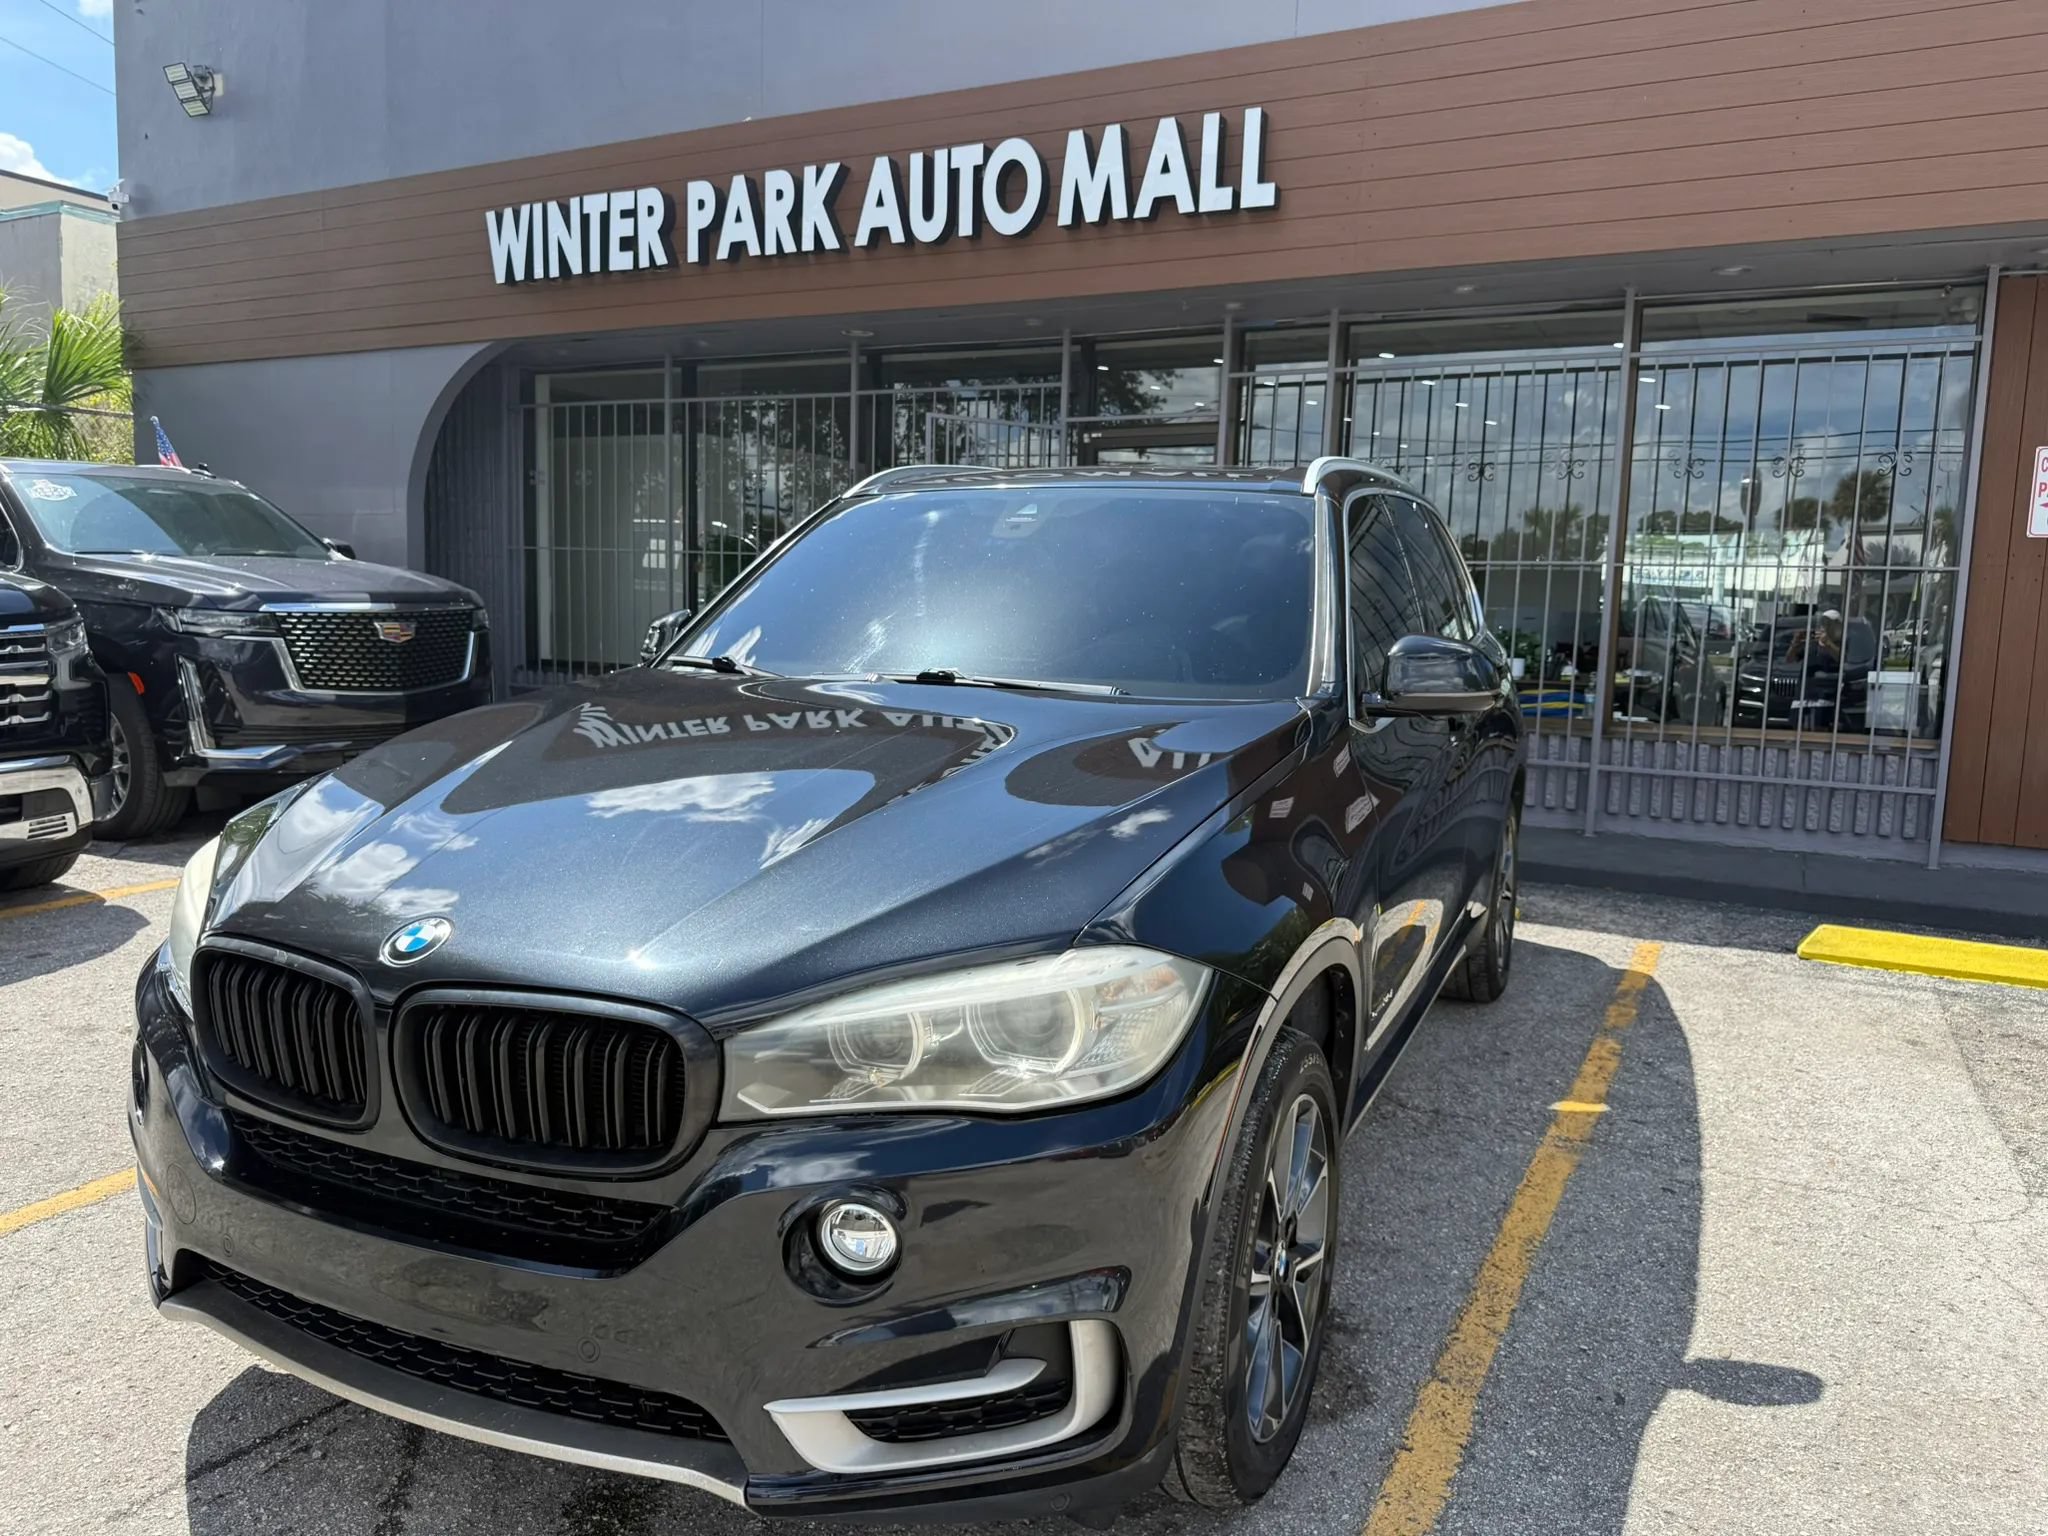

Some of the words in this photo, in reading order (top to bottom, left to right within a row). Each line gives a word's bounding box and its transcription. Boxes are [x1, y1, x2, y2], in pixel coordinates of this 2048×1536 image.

[485, 187, 669, 284] WINTER
[687, 162, 841, 263] PARK
[854, 137, 1043, 246] AUTO
[1057, 107, 1276, 227] MALL
